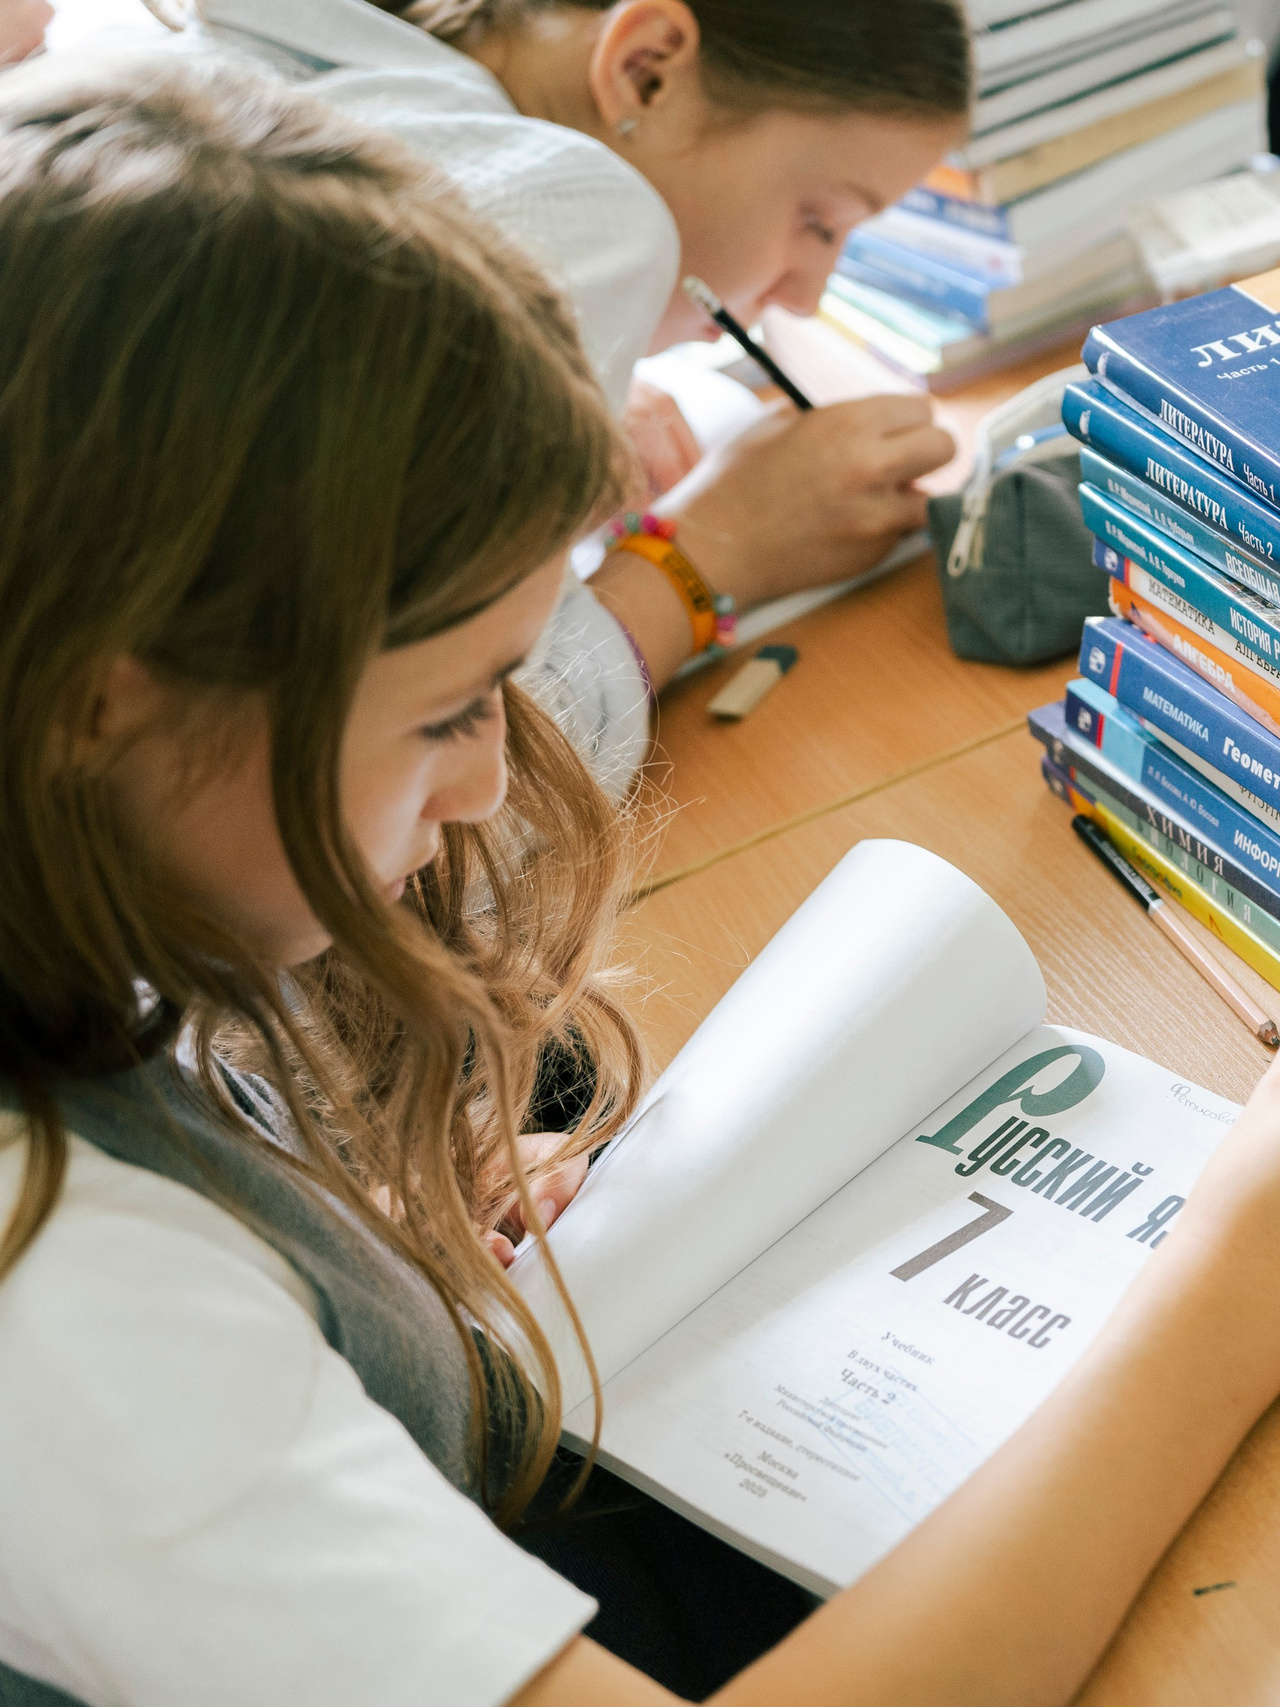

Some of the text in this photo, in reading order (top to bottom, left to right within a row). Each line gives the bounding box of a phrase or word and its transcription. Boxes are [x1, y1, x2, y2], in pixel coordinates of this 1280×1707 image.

[1216, 357, 1280, 379] Часть 1
[1159, 399, 1236, 473] ЛИТЕРАТУРА
[1243, 463, 1268, 496] Часть
[1269, 482, 1276, 501] 1
[1145, 457, 1230, 531] ЛИТЕРАТУРА
[1238, 521, 1266, 556] Часть
[1266, 541, 1275, 561] 2
[1225, 551, 1280, 604] ВСЕОБЩАЯ
[1148, 577, 1215, 635] МАТЕМАТИКА
[1229, 607, 1272, 655] ИСТОРИЯ
[1173, 634, 1236, 693] АЛГЕБРА
[1143, 687, 1210, 742] МАТЕМАТИКА
[1145, 804, 1225, 878] ХИМИЯ
[915, 1044, 1154, 1223] Русский
[888, 1191, 1015, 1283] 7
[942, 1273, 1071, 1350] класс
[847, 1349, 919, 1392] В двух частях
[881, 1331, 936, 1365] Учебник
[841, 1367, 897, 1405] Часть 2
[757, 1450, 798, 1480] Москва
